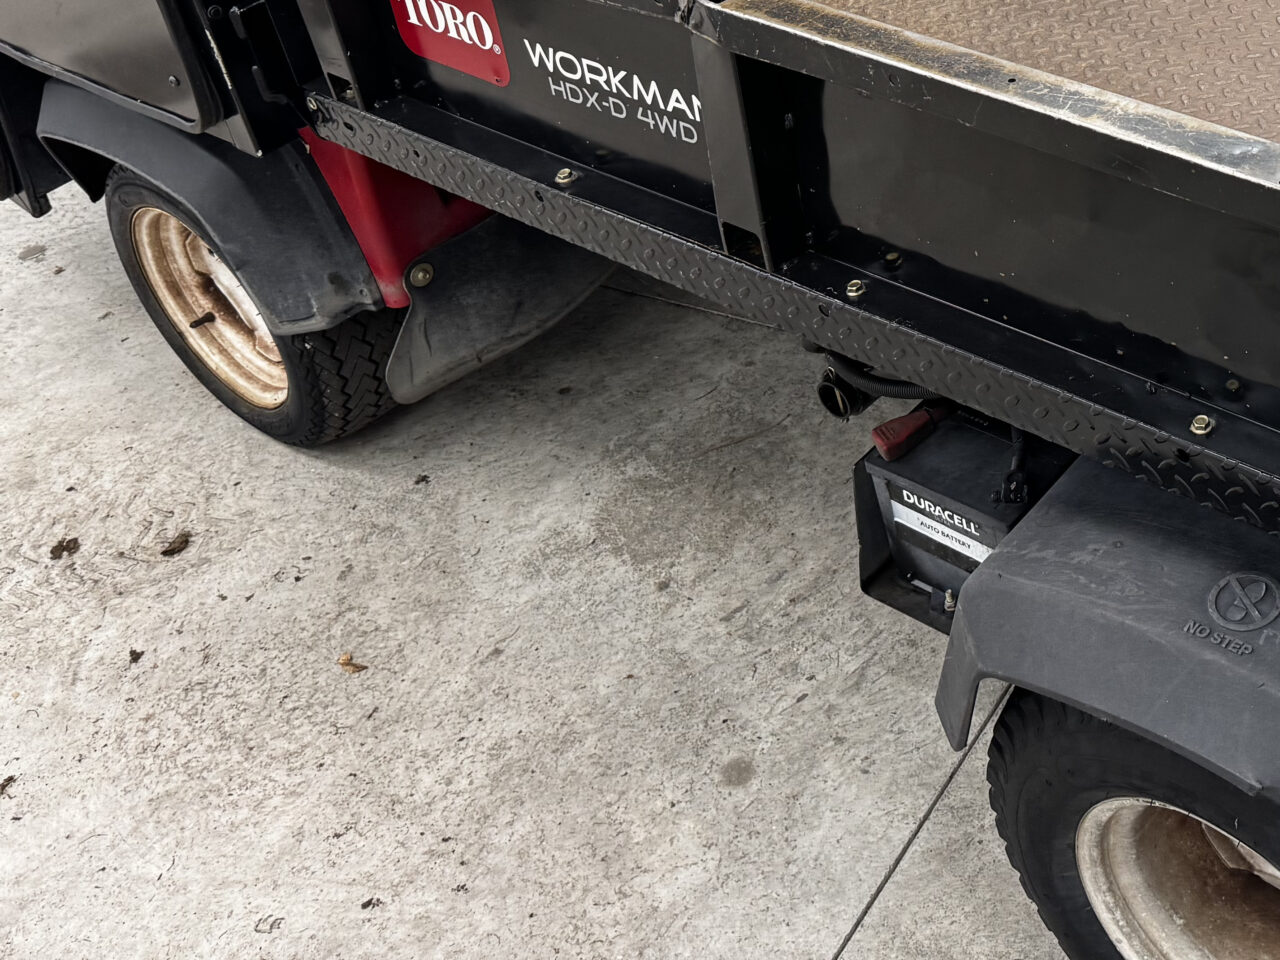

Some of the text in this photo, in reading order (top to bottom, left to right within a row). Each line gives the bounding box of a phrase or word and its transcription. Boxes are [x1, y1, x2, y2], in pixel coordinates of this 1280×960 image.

[548, 76, 698, 144] HDX-D 4WD
[902, 489, 980, 536] DURACELL
[920, 520, 971, 550] AUTO BATTERY
[1183, 620, 1255, 656] NO STEP
